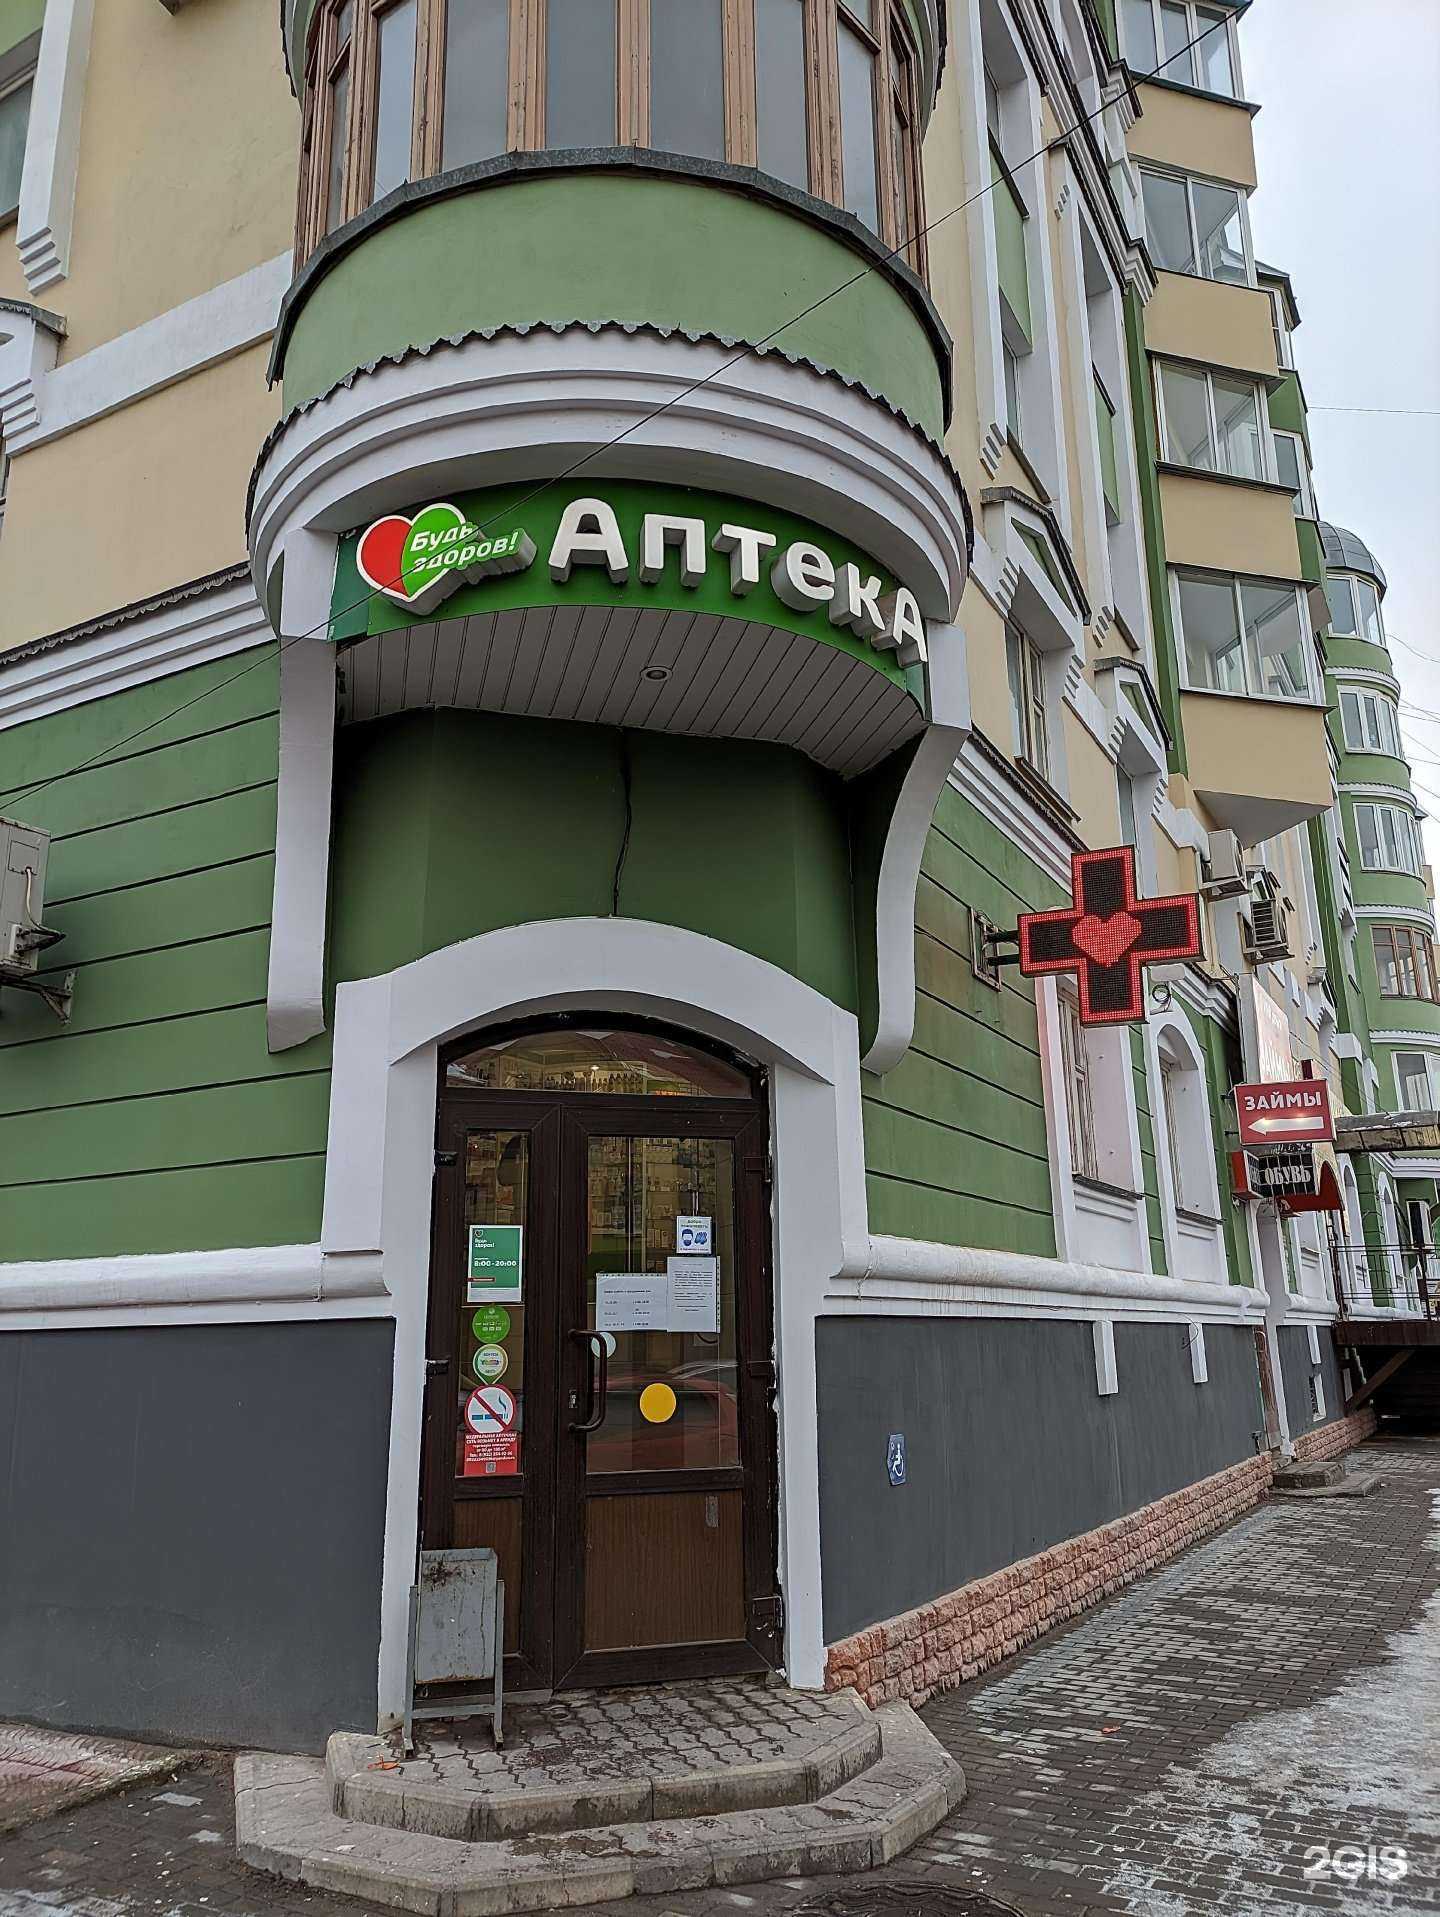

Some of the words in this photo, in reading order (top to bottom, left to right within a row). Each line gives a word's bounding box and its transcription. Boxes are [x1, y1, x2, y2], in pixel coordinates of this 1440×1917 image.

[410, 525, 474, 552] Будь
[412, 531, 519, 573] здоров!
[1244, 1091, 1322, 1111] ЗАЙМЫ
[1264, 1165, 1311, 1185] ОБУВЬ
